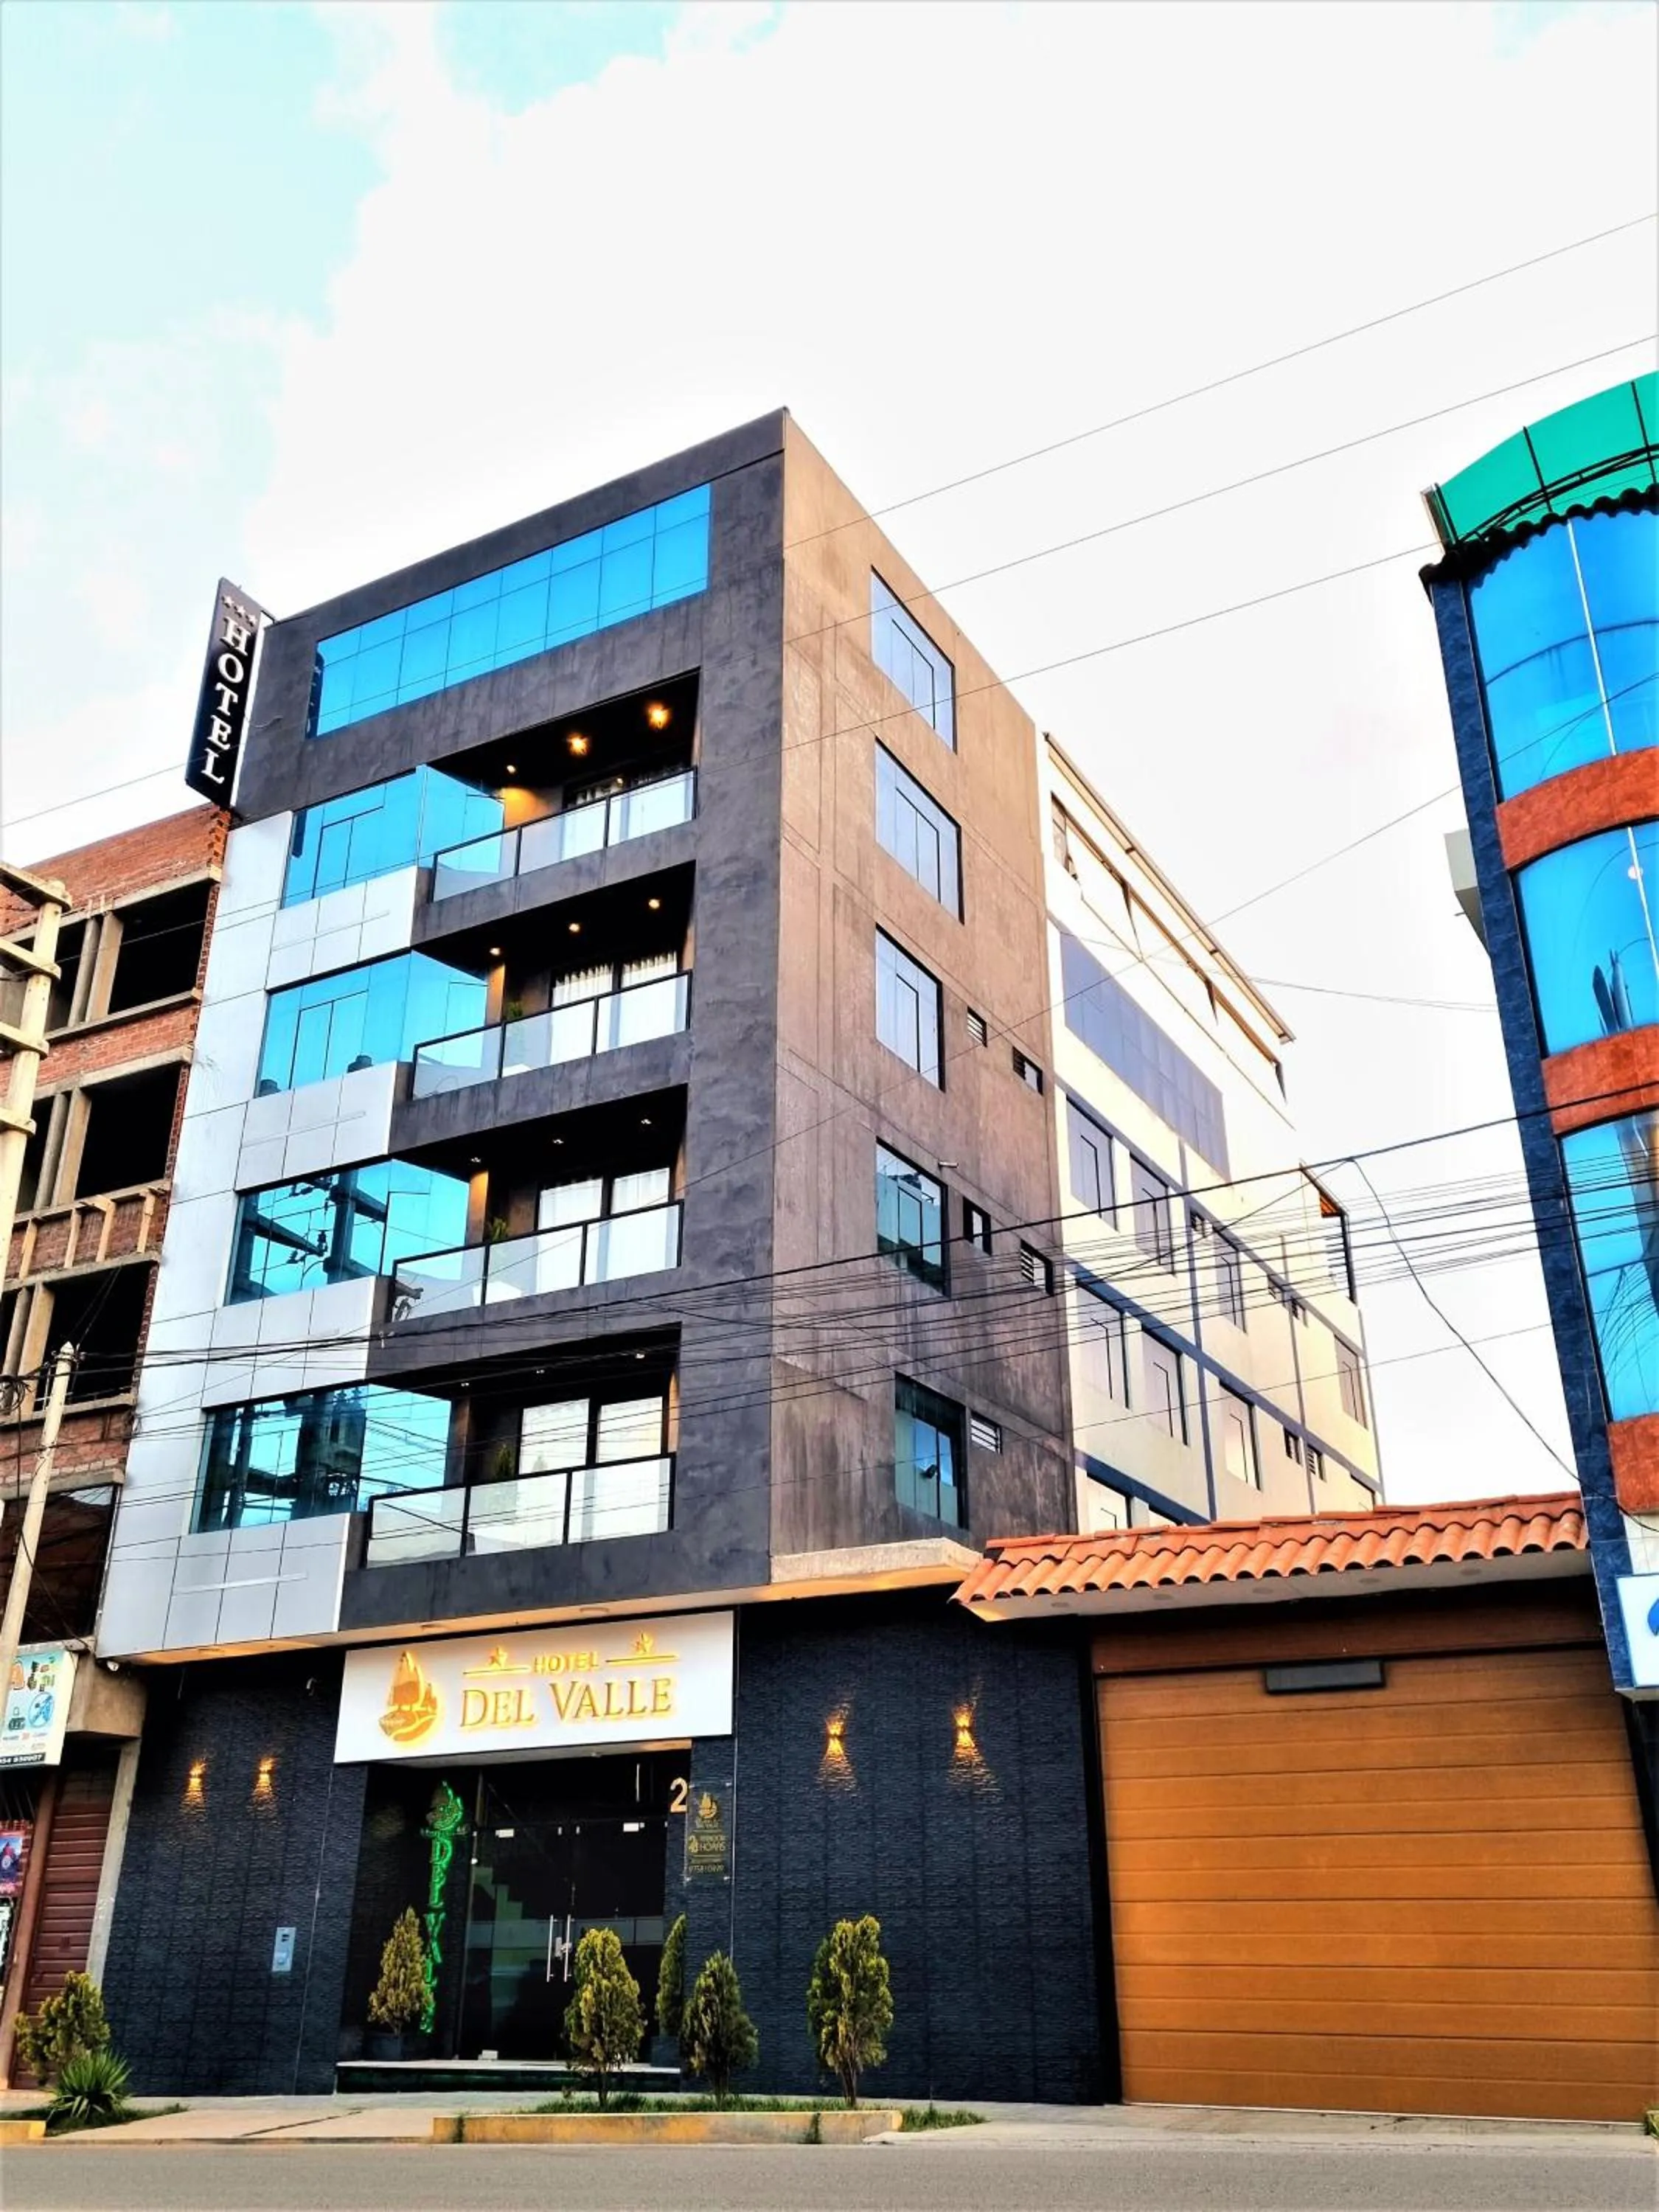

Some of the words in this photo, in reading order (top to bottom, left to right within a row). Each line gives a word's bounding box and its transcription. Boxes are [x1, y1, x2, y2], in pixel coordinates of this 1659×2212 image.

[201, 616, 251, 785] HOTEL
[532, 1652, 599, 1674] HOTEL
[459, 1688, 535, 1728] DEL
[549, 1677, 672, 1720] VALLE
[670, 1777, 688, 1813] 2
